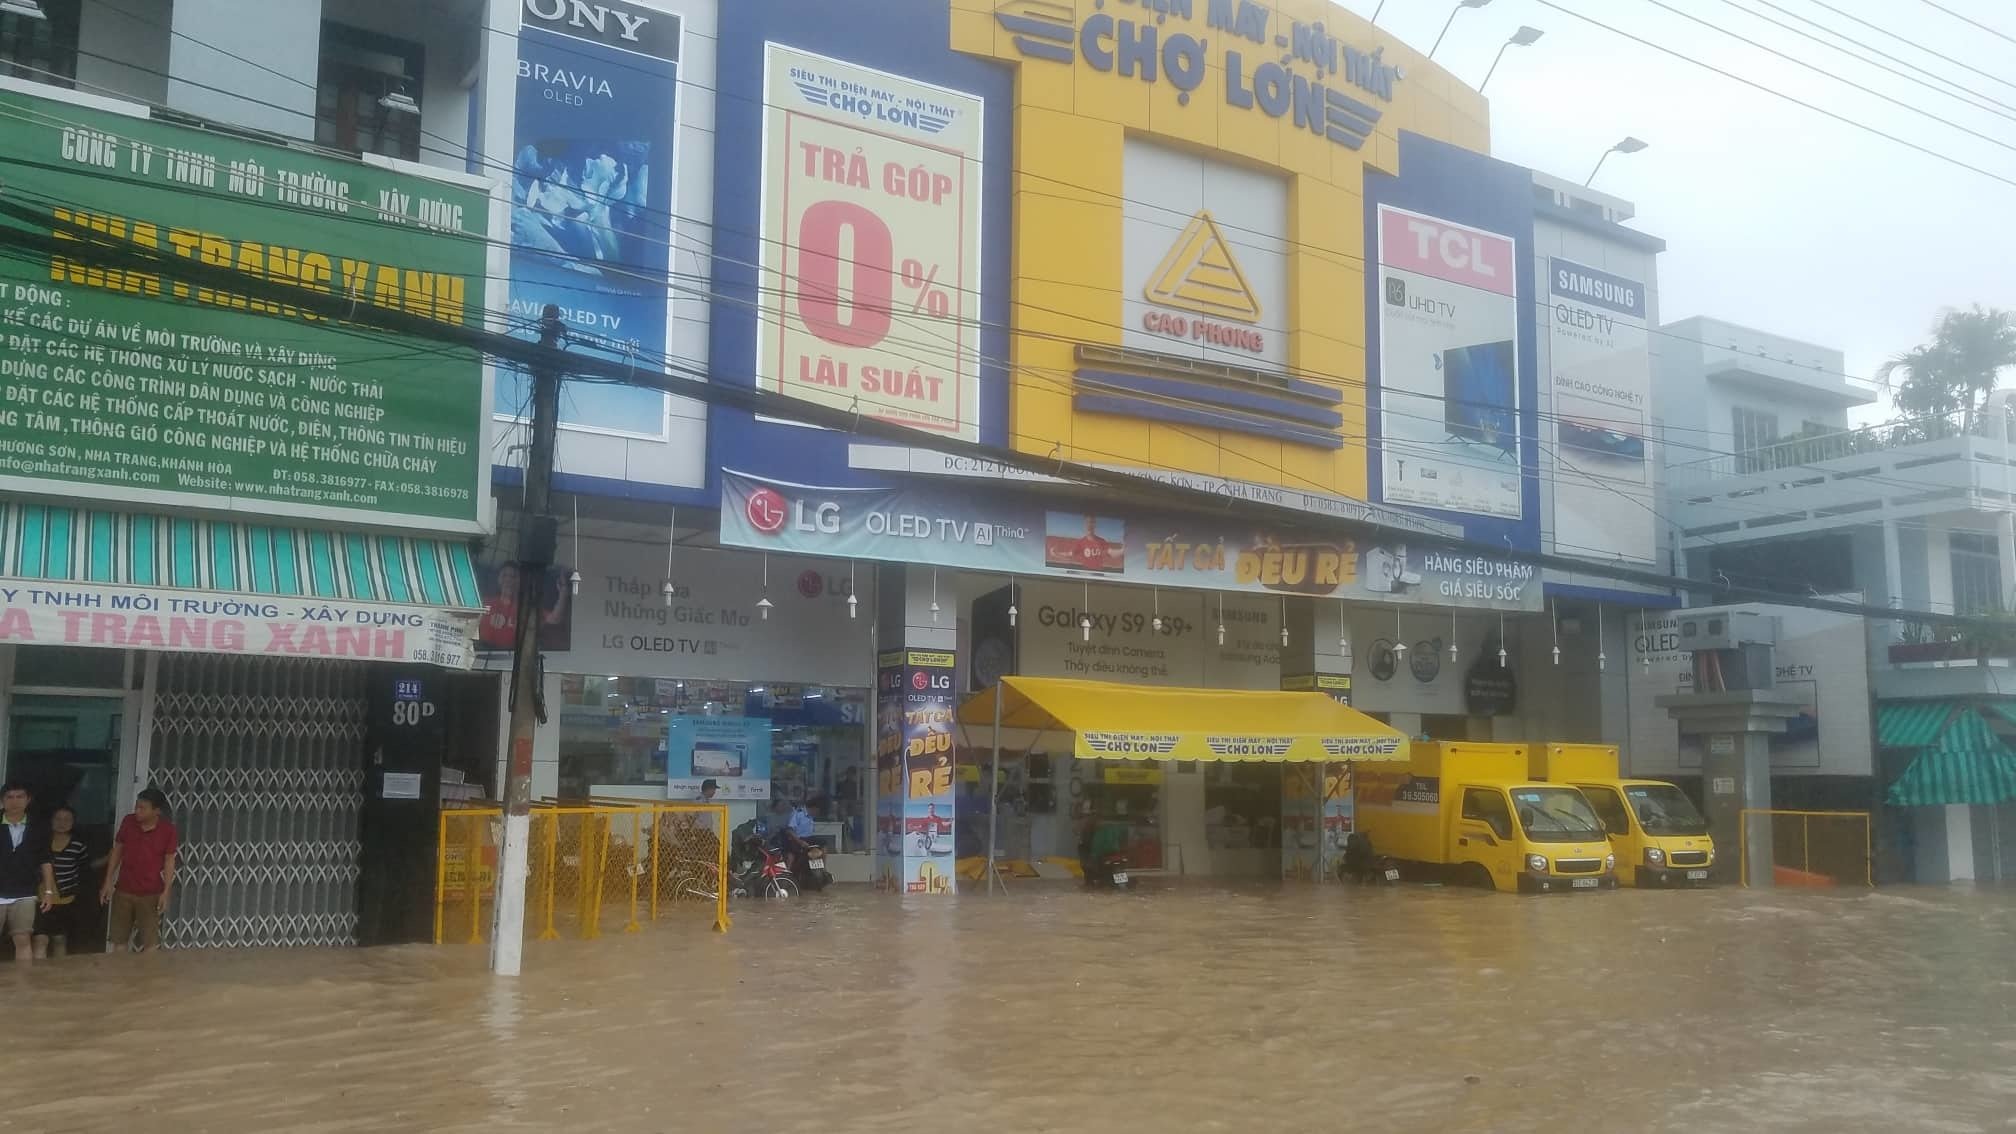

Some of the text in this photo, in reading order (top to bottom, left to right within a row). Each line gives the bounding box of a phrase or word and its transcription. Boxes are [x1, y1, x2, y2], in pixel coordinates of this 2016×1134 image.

[517, 59, 613, 98] BRAVIA
[1080, 13, 1326, 136] CHỢ LỚN
[543, 88, 584, 107] OLED
[61, 122, 464, 236] CÔNG TY TNHH MÔI TRƯỜNG XÂY DỰNG
[800, 141, 953, 206] TRẢ GÓP
[1408, 218, 1496, 277] TCL
[1409, 295, 1456, 318] UHD TV
[1558, 269, 1634, 308] SAMSUNG
[30, 311, 63, 332] CÁC
[146, 329, 175, 348] MÔI
[181, 335, 241, 356] TRƯỜNG
[267, 345, 295, 365] XÂY
[600, 314, 622, 331] TV
[1144, 311, 1264, 352] CAO PHONG
[1555, 303, 1614, 336] QLED TV
[46, 337, 79, 359] CÁC
[258, 369, 296, 388] SẠCH
[310, 375, 347, 394] NƯỚC
[799, 354, 944, 402] LÃI SUẤT
[53, 365, 86, 386] CÁC
[91, 369, 135, 391] CÔNG
[139, 376, 185, 397] TRÌNH
[189, 381, 221, 401] DÂN
[225, 388, 264, 408] DỤNG
[269, 389, 286, 409] VÀ
[291, 394, 329, 415] CÔNG
[334, 401, 385, 424] NGHIỆP
[6, 385, 38, 406] ĐẶT
[42, 388, 74, 408] CÁC
[80, 393, 100, 414] HỆ
[106, 395, 158, 418] THỐNG
[163, 399, 193, 421] CẤP
[197, 408, 246, 428] THOÁT
[339, 425, 385, 445] THÔNG
[389, 432, 410, 447] TIN
[413, 433, 434, 450] TÍN
[437, 437, 466, 457] HIỆU
[71, 417, 125, 439] THÔNG
[131, 421, 158, 442] GIÓ
[163, 426, 206, 447] CÔNG
[211, 435, 267, 457] NGHIỆP
[270, 440, 287, 457] VÀ
[291, 442, 309, 461] HỆ
[312, 444, 360, 465] THỐNG
[364, 450, 399, 470] CHỮA
[402, 455, 437, 474] CHÁY
[85, 449, 111, 463] NHA
[178, 473, 232, 490] Website:
[235, 482, 378, 505] www.nhatrangxanh.com
[794, 501, 840, 533] LG
[865, 512, 931, 539] OLED
[935, 518, 969, 543] TV
[1424, 552, 1462, 573] HÀNG
[1465, 557, 1493, 576] SIÊU
[1440, 578, 1462, 597] GIÁ
[1465, 580, 1493, 599] SIÊU
[27, 589, 424, 629] TNHH MÔI TRƯỜNG XÂY DỰNG
[1121, 612, 1145, 633] S9
[57, 610, 247, 653] TRANG
[265, 622, 407, 658] XANH
[630, 635, 674, 652] OLED
[678, 639, 700, 654] TV
[398, 682, 418, 693] 214
[931, 675, 950, 689] LG
